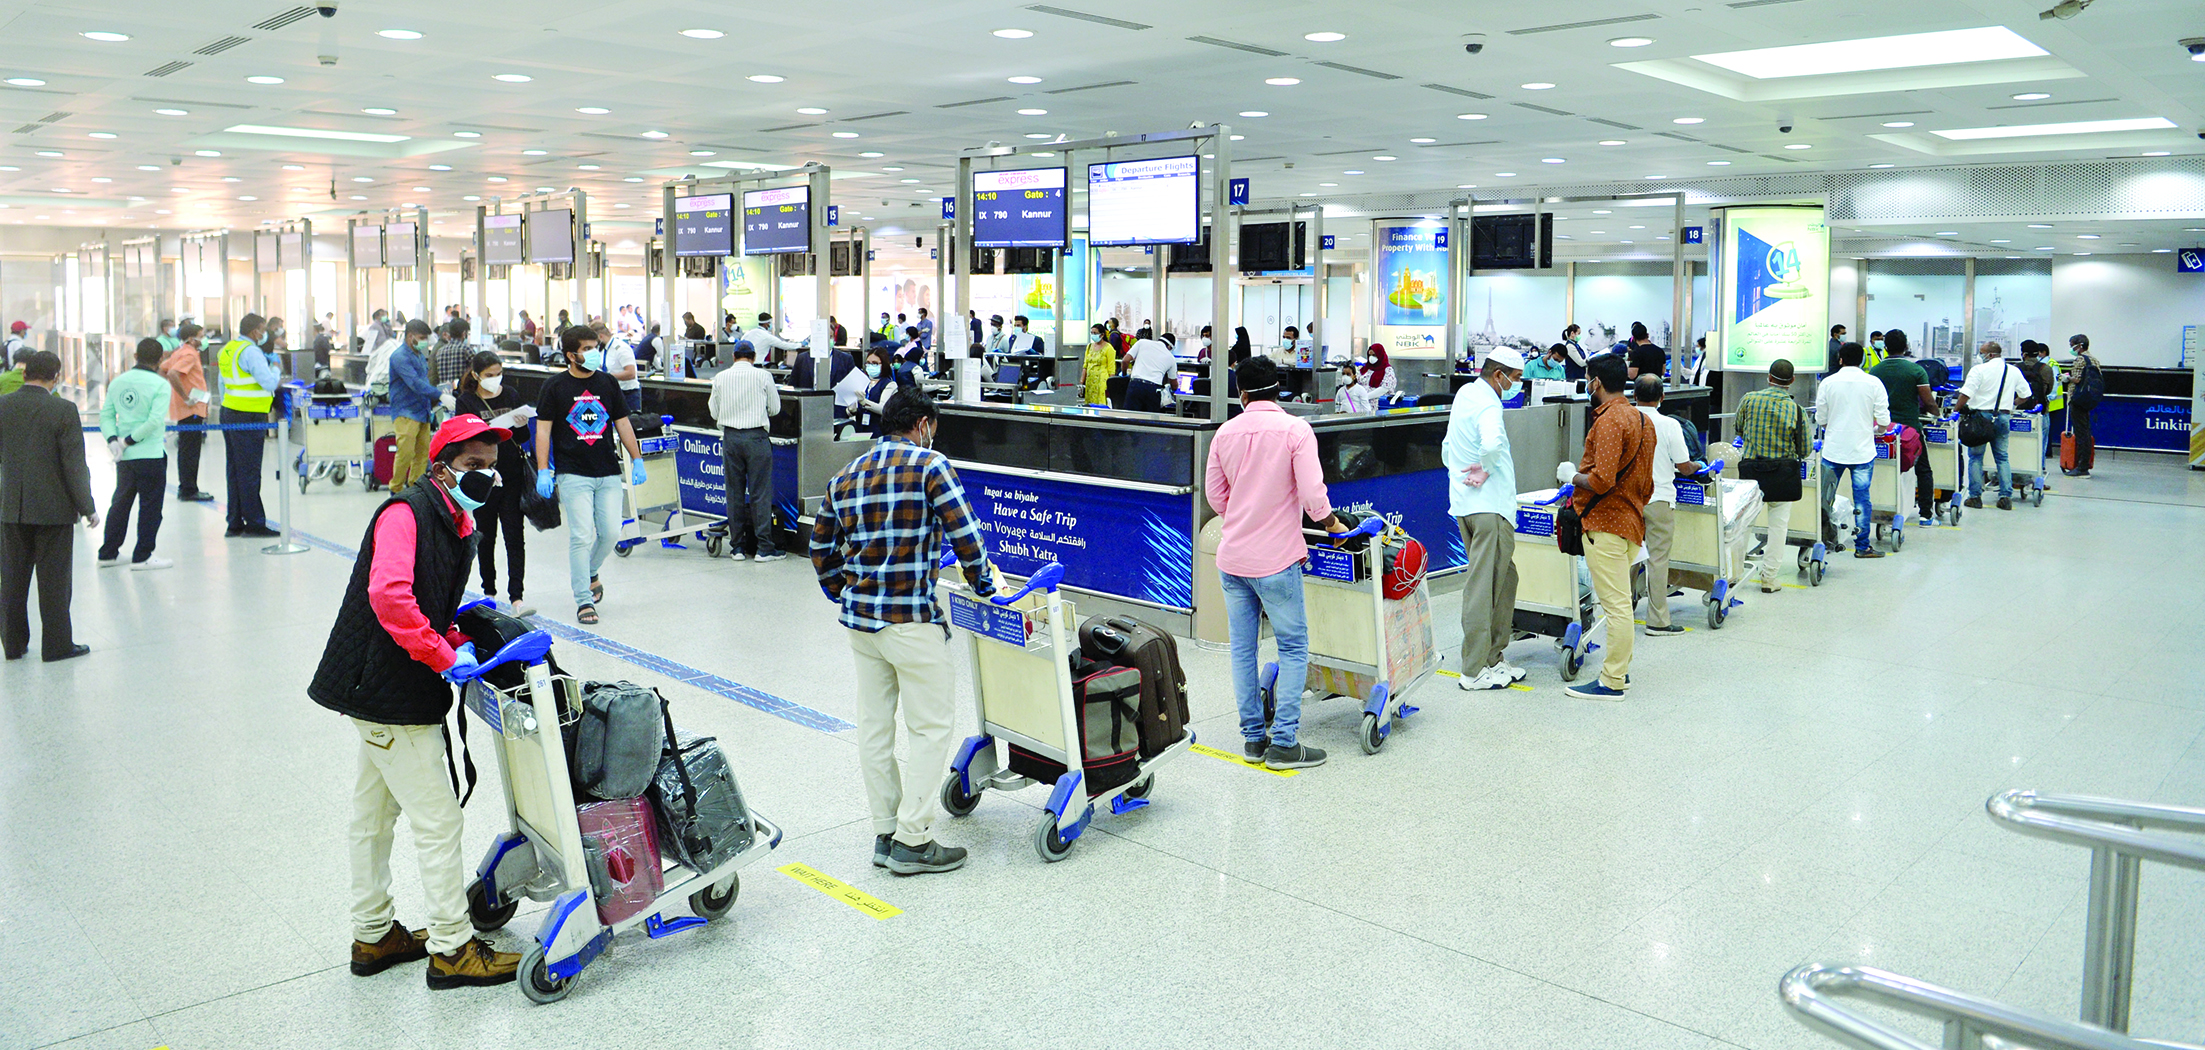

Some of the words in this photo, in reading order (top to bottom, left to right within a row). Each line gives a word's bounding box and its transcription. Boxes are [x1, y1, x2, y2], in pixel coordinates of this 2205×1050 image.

[1121, 165, 1163, 175] Departure
[1164, 162, 1194, 171] Flights
[998, 174, 1040, 186] express
[976, 192, 998, 201] 14:10
[1024, 190, 1044, 199] Gate
[1054, 189, 1062, 198] 4
[1233, 183, 1245, 197] 17
[690, 199, 716, 209] express
[761, 192, 790, 205] express
[746, 208, 761, 216] 14:10
[800, 203, 806, 211] 4
[945, 201, 955, 213] 16
[829, 210, 837, 220] 15
[978, 211, 988, 220] IX
[993, 210, 1008, 219] 790
[1021, 209, 1052, 219] Kannur
[687, 227, 697, 235] 790
[704, 226, 724, 235] Kannur
[758, 223, 769, 231] 790
[777, 221, 800, 230] Kannur
[1392, 232, 1423, 241] Finance
[1437, 235, 1446, 244] 19
[1688, 230, 1699, 239] 18
[1324, 237, 1334, 246] 20
[1381, 243, 1414, 254] Property
[1414, 243, 1435, 252] With
[1771, 248, 1802, 276] 14
[730, 265, 746, 282] 14
[1395, 333, 1421, 342] الوطني
[2145, 404, 2185, 416] بالعالم
[581, 413, 598, 421] NYC
[2145, 417, 2192, 431] Linkin
[684, 438, 711, 455] Online
[700, 460, 725, 476] Count
[984, 485, 1003, 500] Ingat
[1004, 491, 1013, 499] sa
[1014, 489, 1039, 504] biyahe
[993, 502, 1019, 518] Have
[1020, 509, 1027, 520] a
[1029, 507, 1053, 526] Safe
[1055, 511, 1077, 531] Trip
[1385, 510, 1404, 528] Trip
[993, 520, 1027, 541] Voyage
[1029, 529, 1056, 543] السلامة
[1056, 534, 1087, 550] رافقتكم
[999, 539, 1030, 557] Shubh
[1031, 545, 1058, 562] Yatra
[1191, 745, 1215, 754] WAIT
[1211, 751, 1238, 761] HERE
[790, 866, 816, 879] WAIT
[810, 875, 839, 891] HERE
